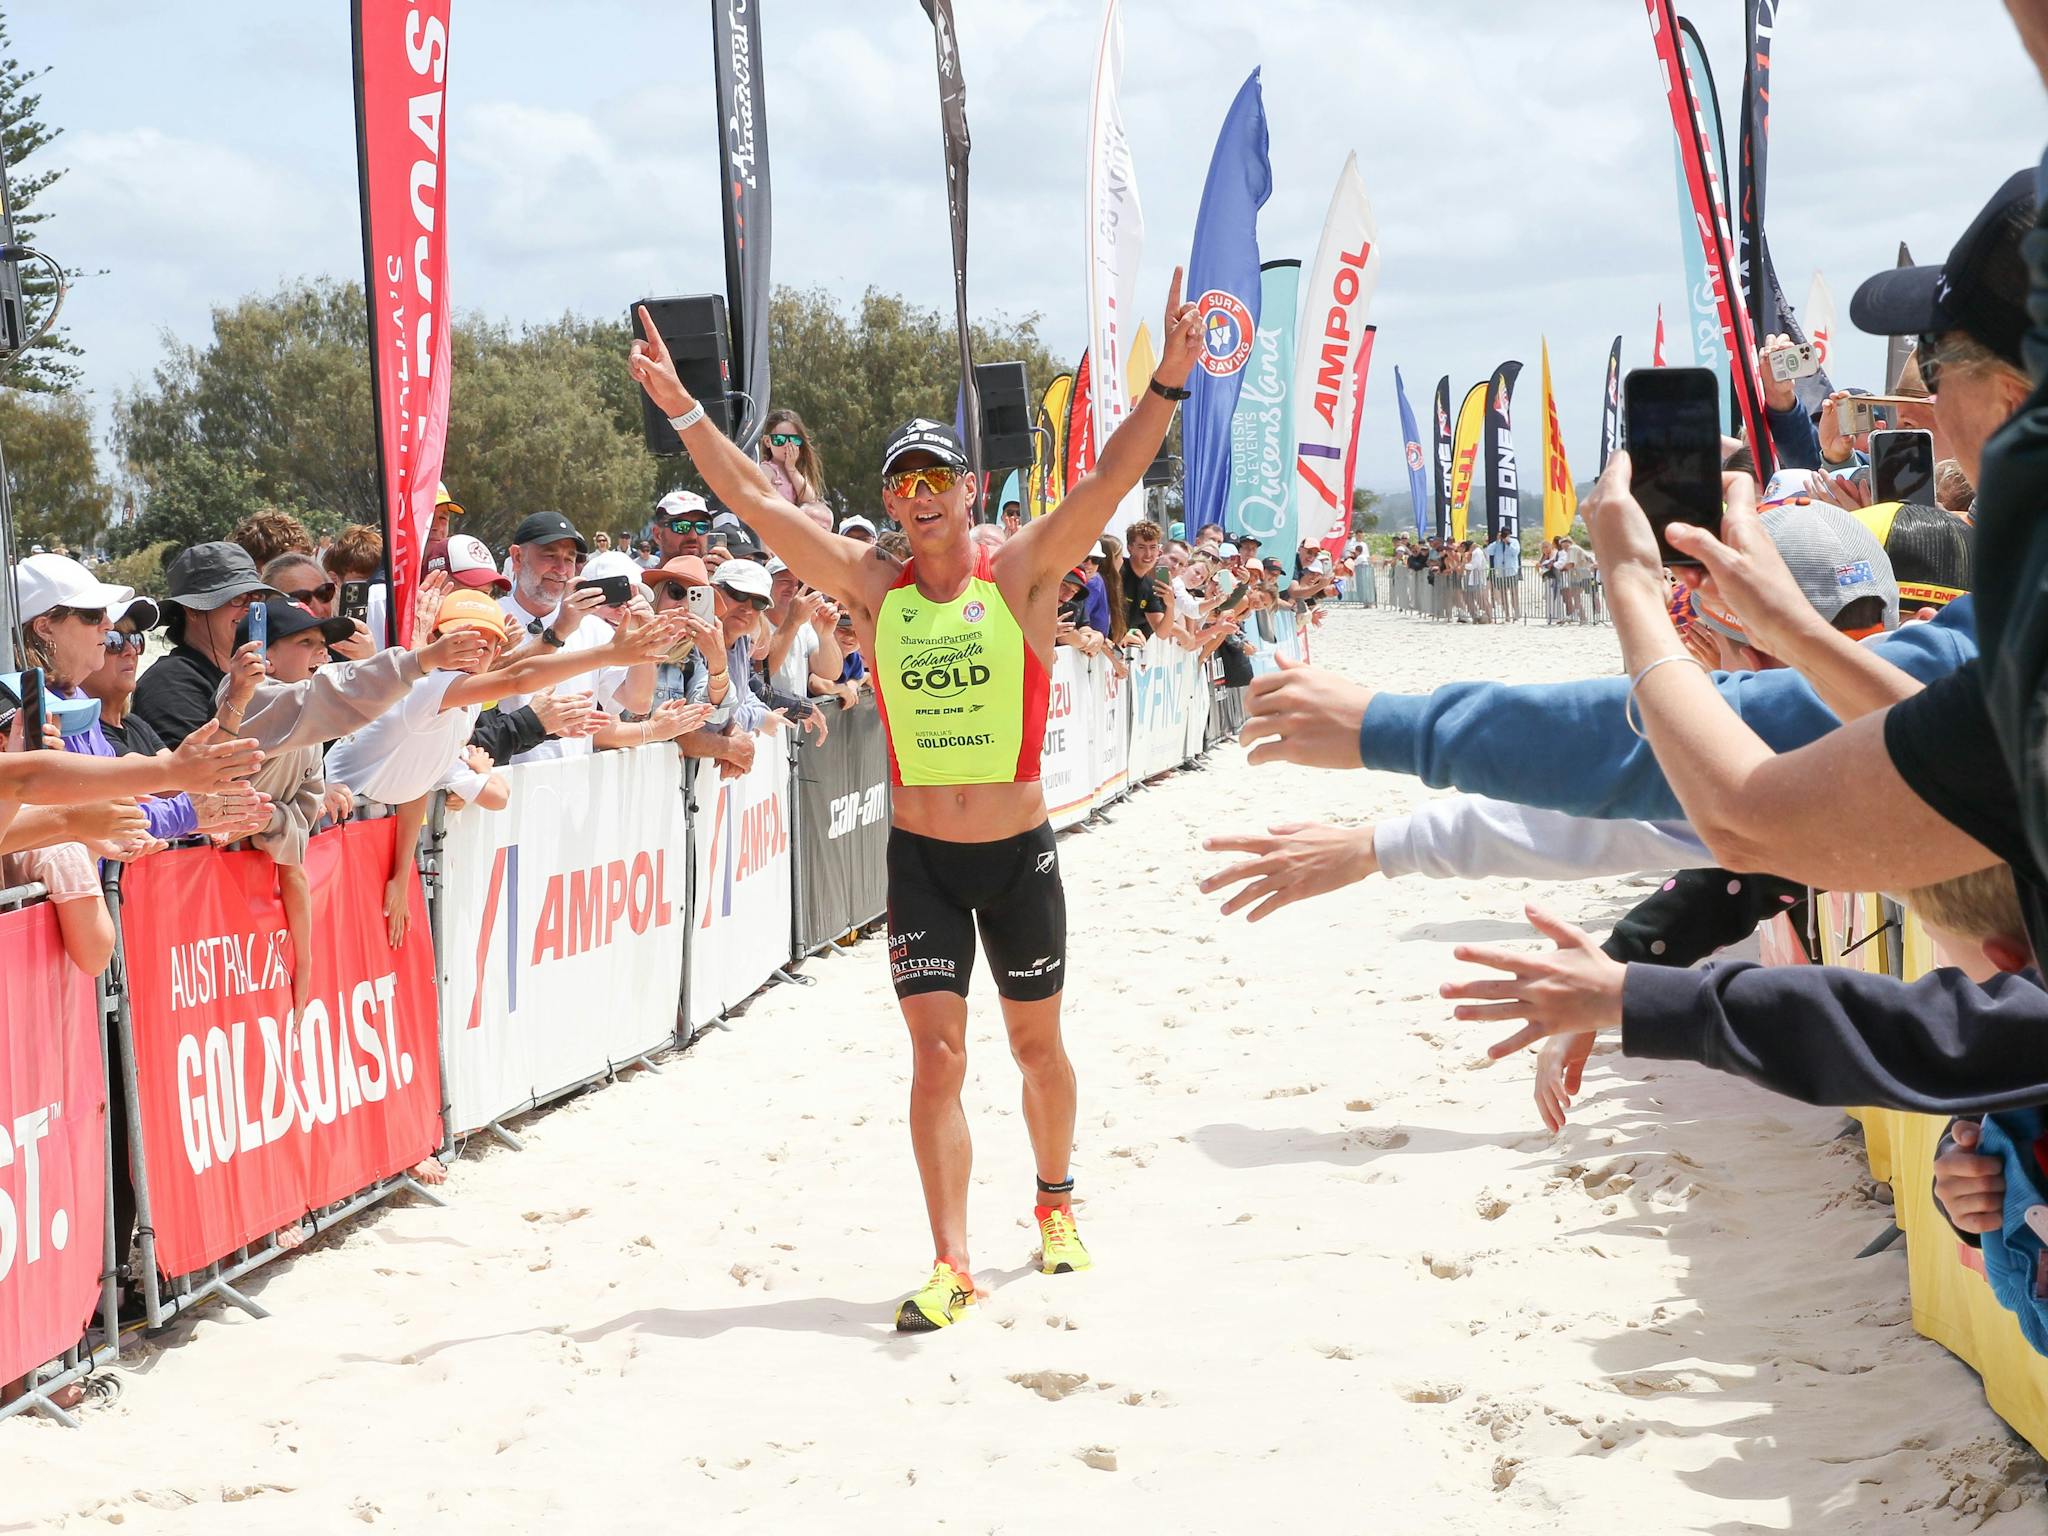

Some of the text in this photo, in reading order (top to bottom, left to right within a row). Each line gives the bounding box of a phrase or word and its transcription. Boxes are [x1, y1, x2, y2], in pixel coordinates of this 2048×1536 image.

[1208, 295, 1242, 313] SURF
[1313, 241, 1372, 430] AMPOL
[1209, 341, 1250, 373] SAVING
[923, 432, 953, 448] ONE
[1238, 327, 1287, 540] Queensland
[1247, 411, 1257, 470] EVENTS
[1235, 411, 1245, 485] TOURISM
[1497, 428, 1517, 490] ONE
[1899, 587, 1931, 598] RACE
[902, 607, 919, 616] FINZ
[900, 630, 983, 646] ShawandPartners
[901, 642, 984, 672] Coolangatta
[901, 664, 990, 690] GOLD
[943, 706, 964, 715] ONE
[915, 730, 952, 738] AUSTRALIA'S
[916, 734, 995, 749] GOLDCOAST.
[828, 780, 886, 840] can-am
[531, 848, 671, 967] AMPOL
[891, 957, 956, 977] Partners
[1008, 969, 1043, 978] RACE
[177, 972, 413, 1176] GOLDCOAST.
